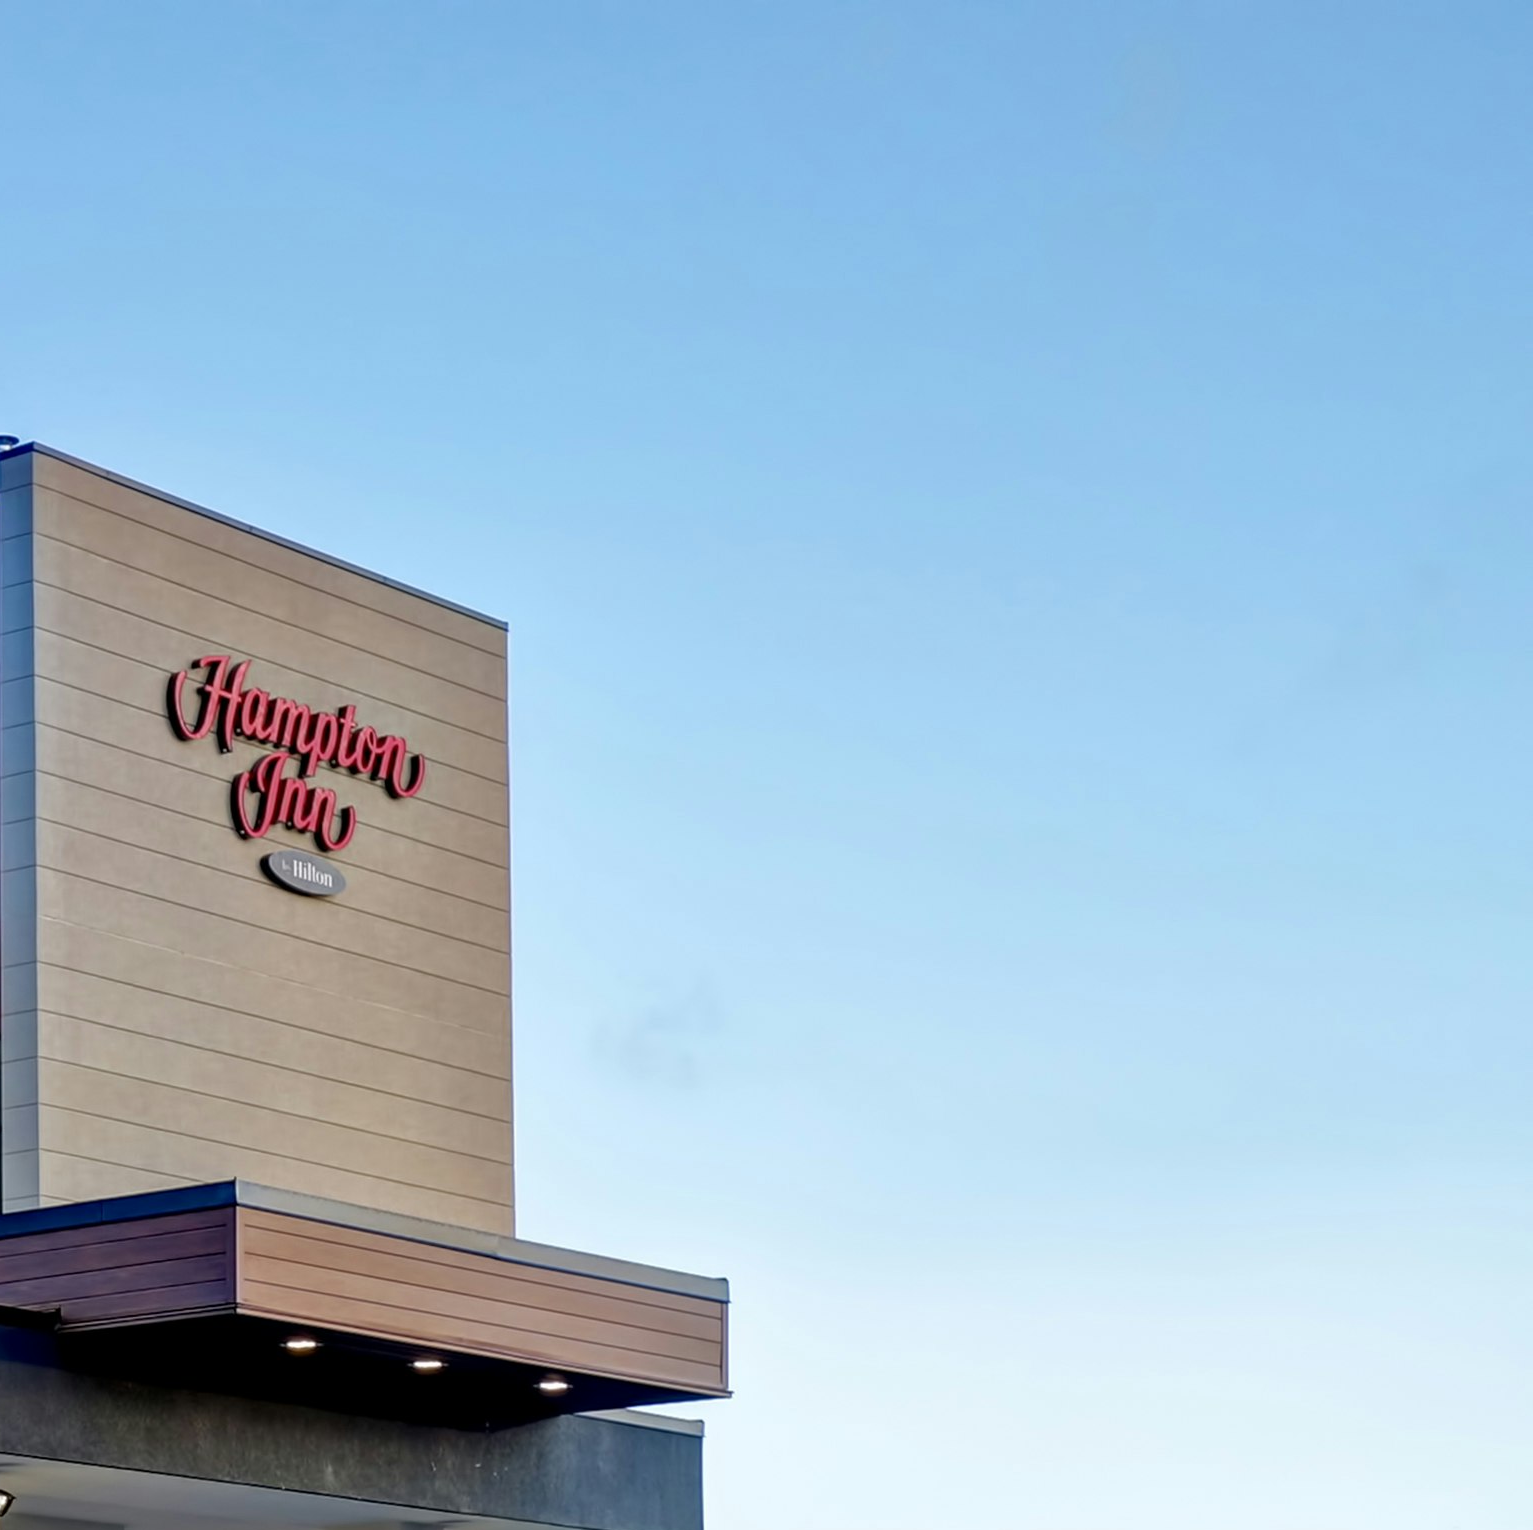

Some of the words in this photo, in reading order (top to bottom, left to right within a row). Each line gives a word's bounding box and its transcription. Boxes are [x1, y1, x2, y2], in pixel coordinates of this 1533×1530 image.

[166, 655, 426, 799] Hampton
[230, 751, 357, 852] Inn
[293, 859, 333, 889] Hilton
